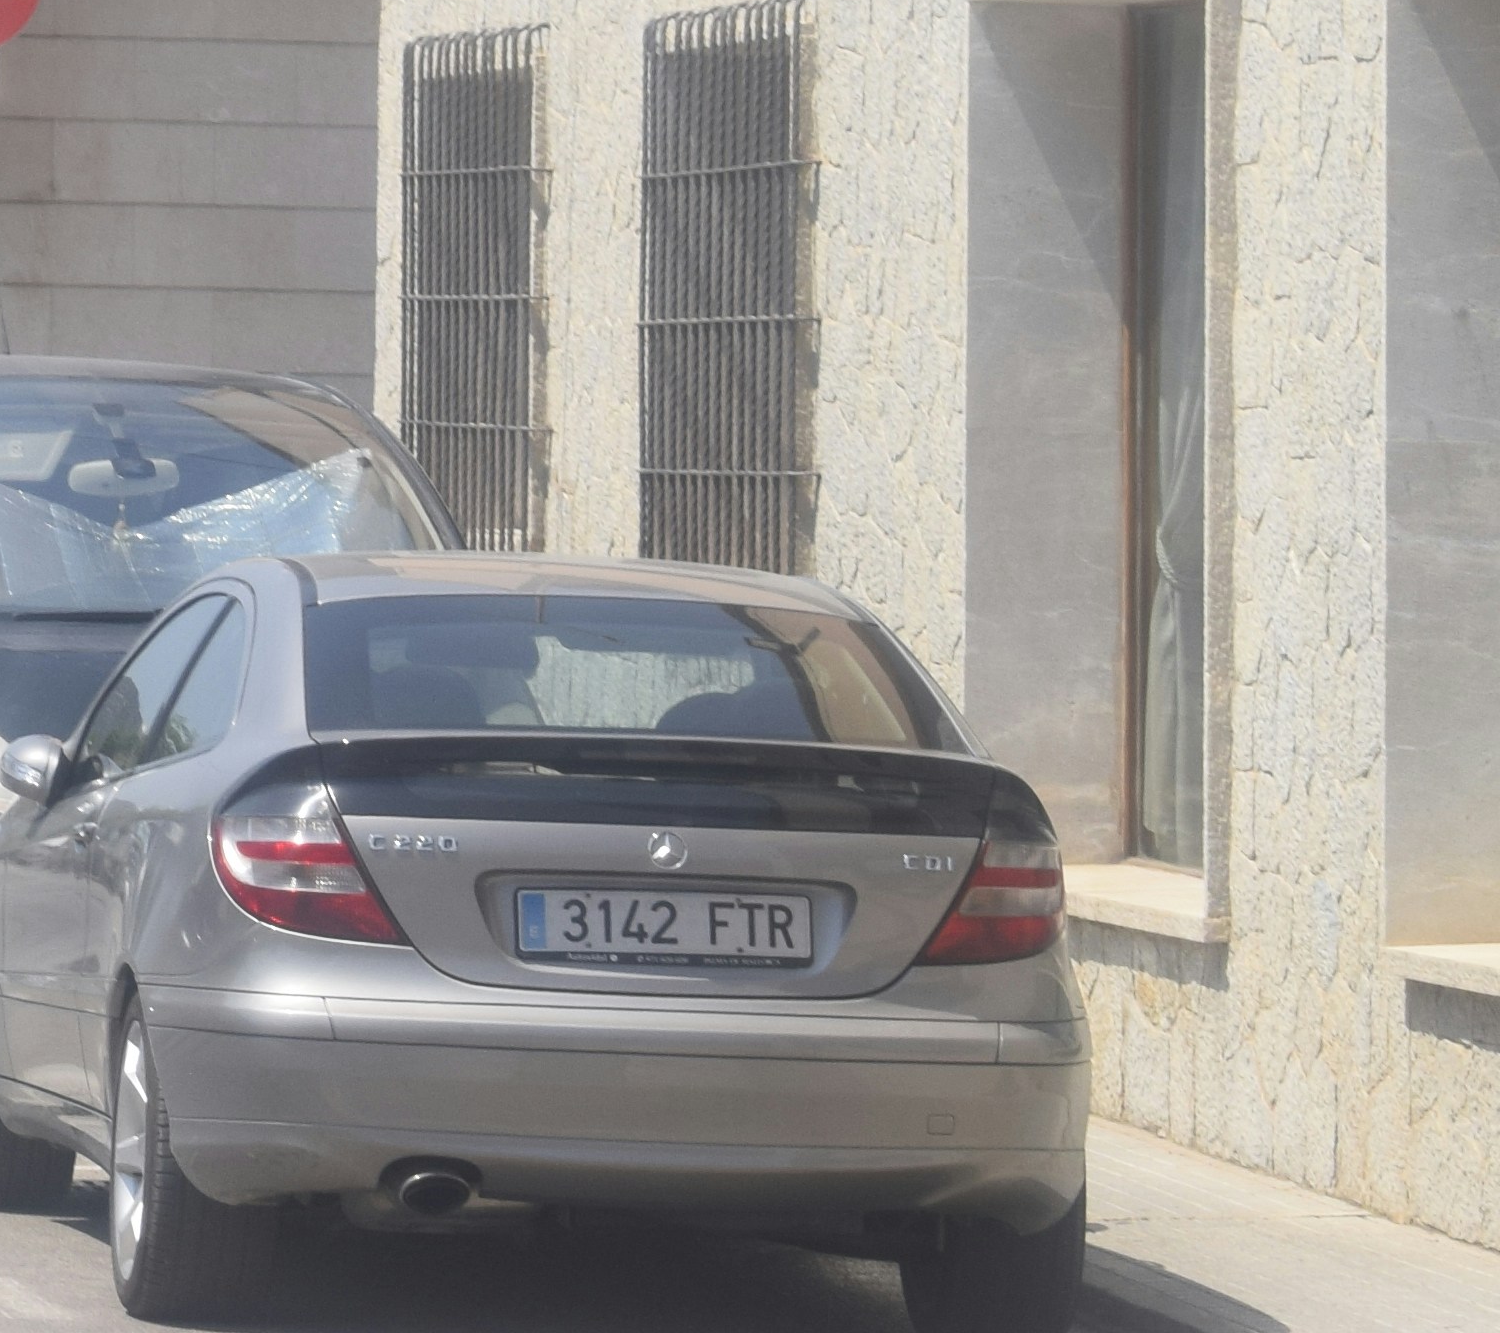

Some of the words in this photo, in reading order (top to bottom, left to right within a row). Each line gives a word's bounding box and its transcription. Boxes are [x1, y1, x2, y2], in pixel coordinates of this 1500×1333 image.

[368, 833, 385, 851] C
[393, 834, 458, 852] 220
[903, 854, 952, 871] CDI
[563, 899, 679, 945] 3142
[708, 901, 795, 949] FTR
